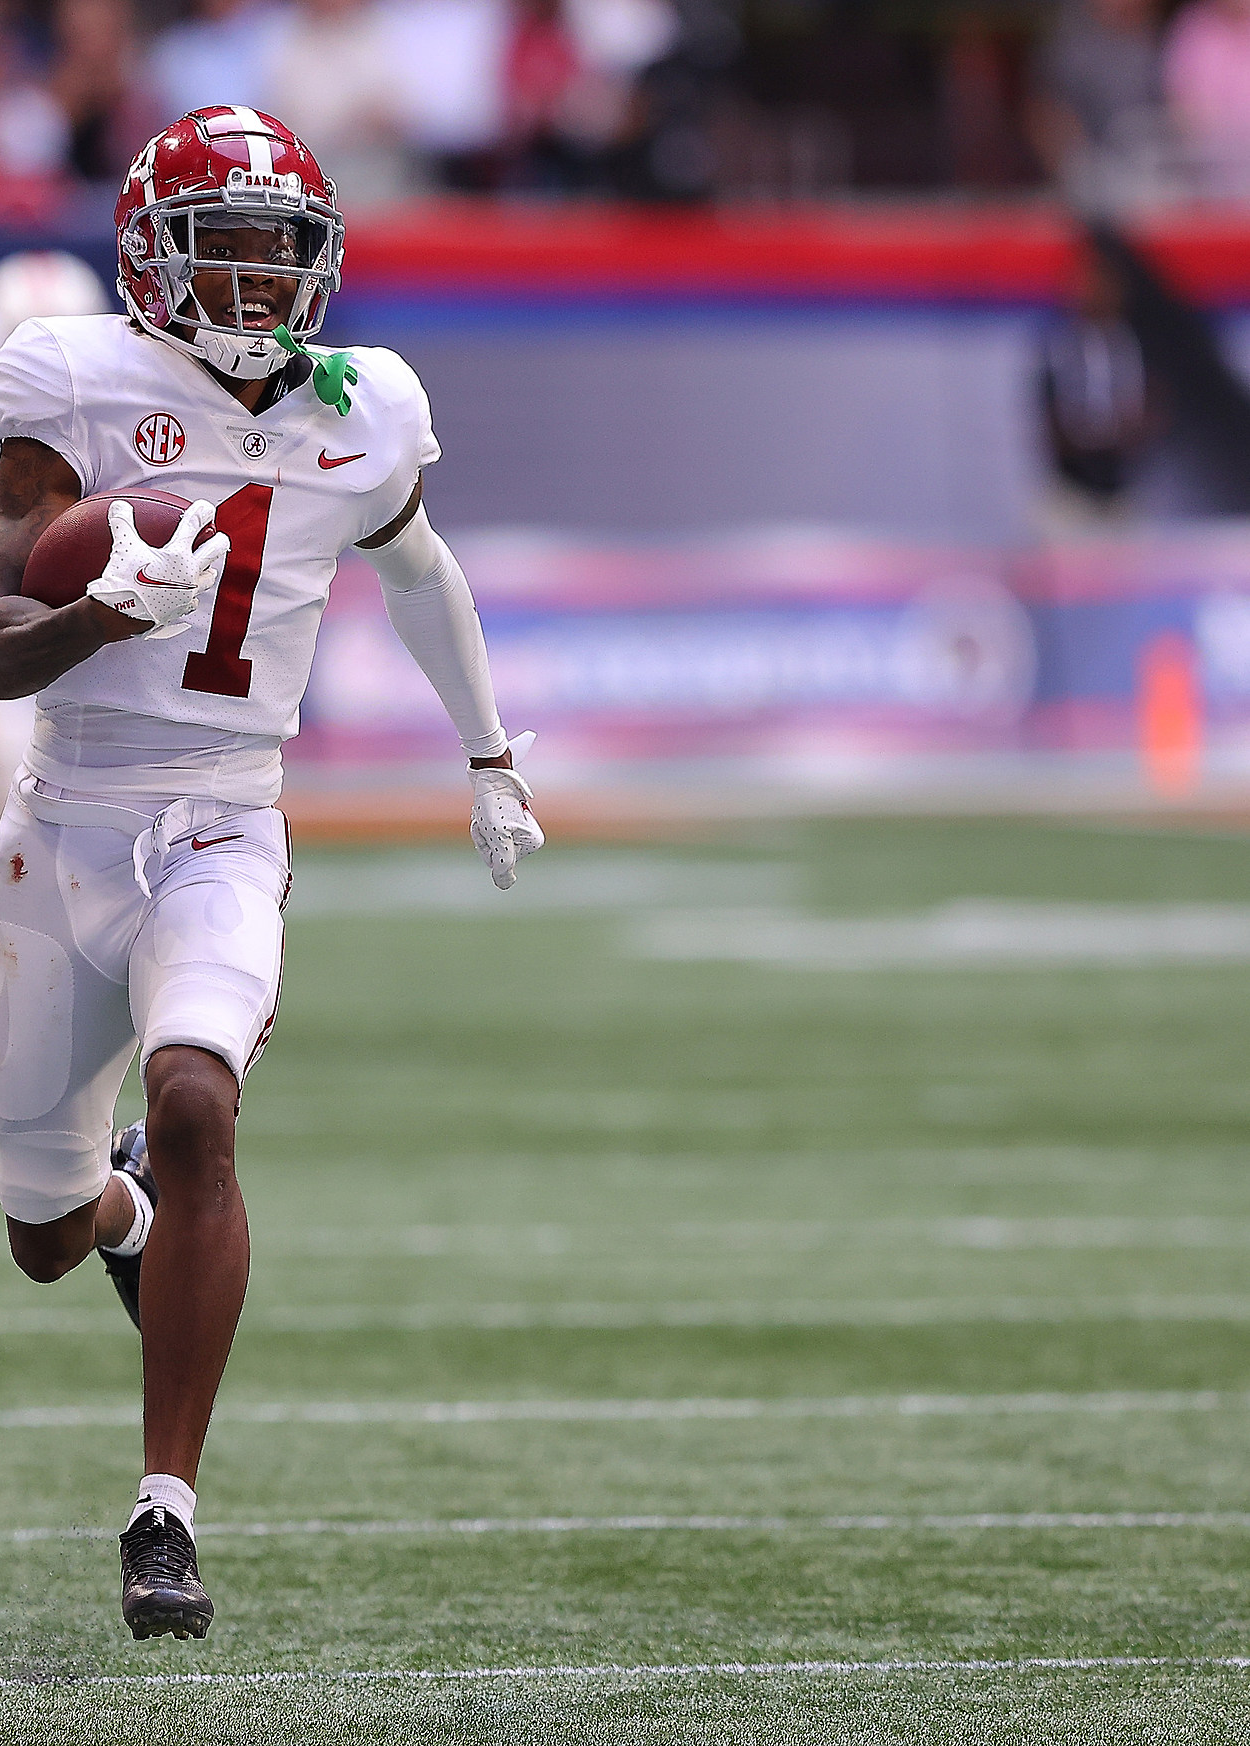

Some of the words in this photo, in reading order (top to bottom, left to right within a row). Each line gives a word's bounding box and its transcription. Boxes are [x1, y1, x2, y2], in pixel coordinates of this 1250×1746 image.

[245, 174, 281, 189] BAMA
[136, 414, 184, 463] SEC
[180, 481, 275, 700] 1
